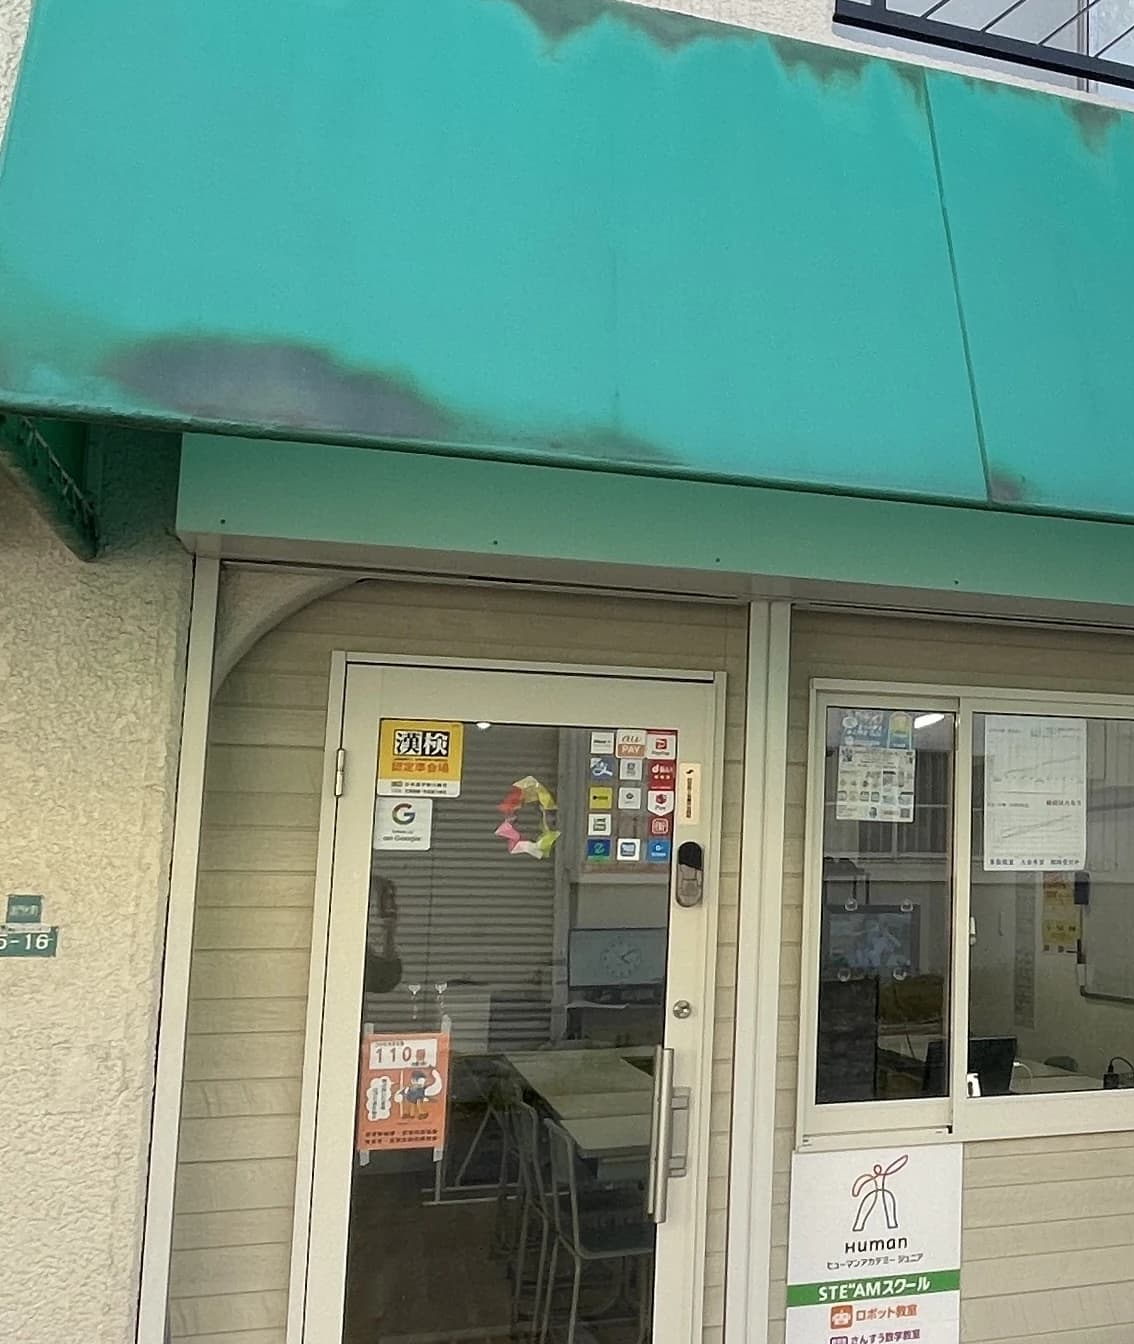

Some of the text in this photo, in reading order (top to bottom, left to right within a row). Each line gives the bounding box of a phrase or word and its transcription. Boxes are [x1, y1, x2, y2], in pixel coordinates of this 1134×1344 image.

[394, 730, 449, 756] 漢検
[621, 745, 641, 754] PAY
[845, 1237, 908, 1254] Human
[856, 1304, 918, 1322] ロボット教室
